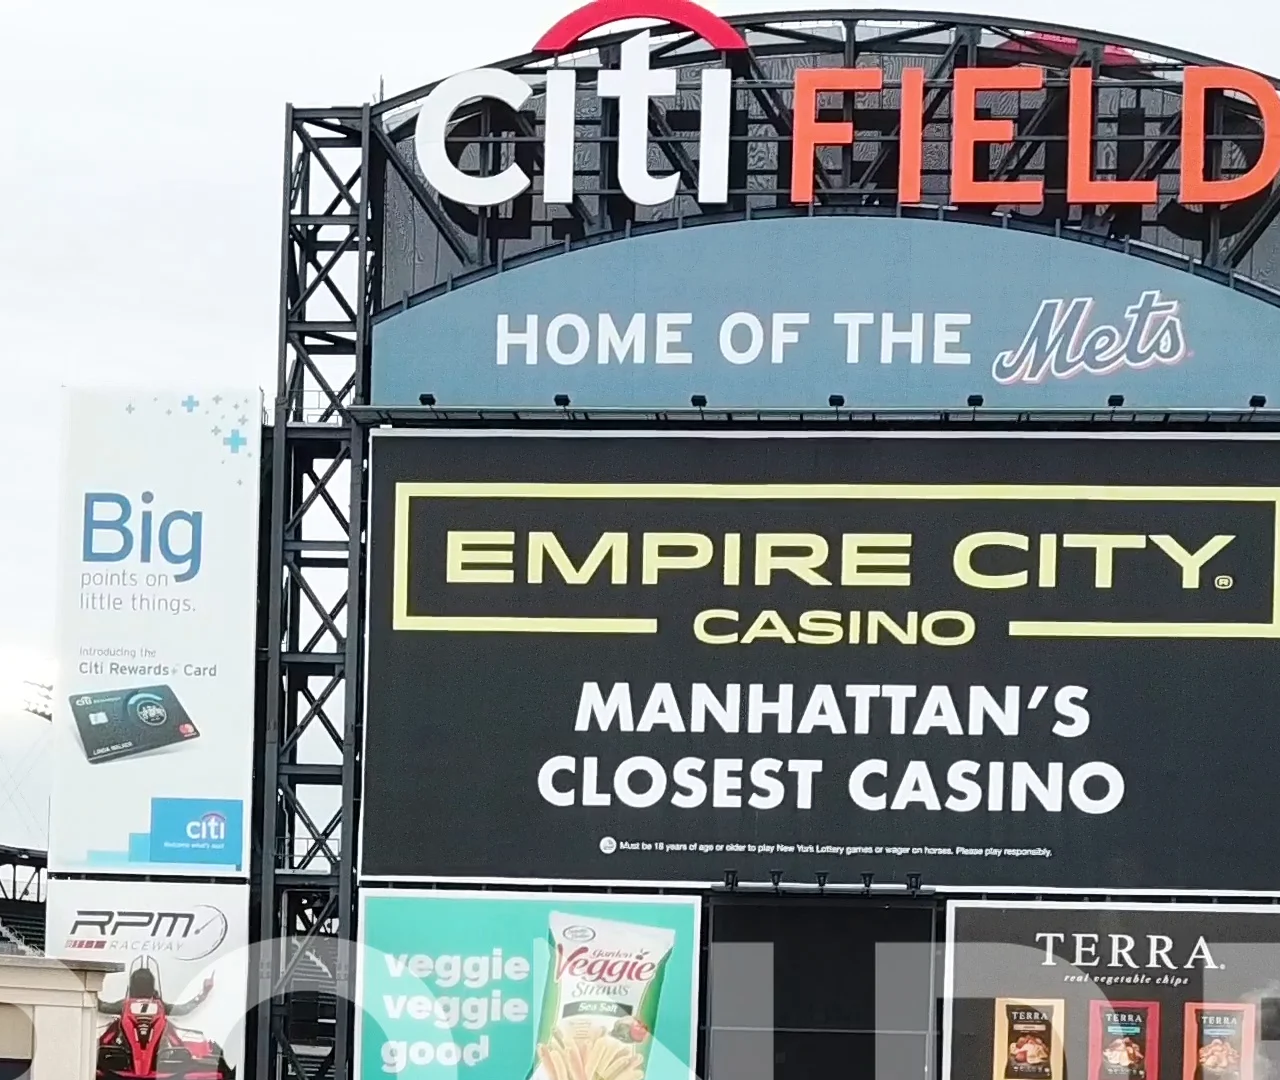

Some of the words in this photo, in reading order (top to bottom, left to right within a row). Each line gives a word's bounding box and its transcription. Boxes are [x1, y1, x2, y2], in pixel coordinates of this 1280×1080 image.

[415, 26, 732, 206] citi
[496, 311, 694, 366] HOME
[718, 311, 811, 365] OF
[832, 312, 971, 365] THE
[992, 291, 1186, 384] Mets
[83, 491, 203, 582] Big
[446, 531, 912, 586] EMPIRE
[81, 569, 138, 588] points
[146, 573, 168, 586] on
[80, 593, 122, 610] little
[132, 593, 196, 615] things.
[693, 610, 976, 645] CASINO
[140, 648, 156, 658] the
[79, 662, 103, 674] Citi
[183, 664, 217, 677] Card
[574, 681, 1089, 737] MANHATTAN'S
[537, 757, 823, 809] CLOSEST
[847, 759, 1125, 814] CASINO
[186, 816, 225, 839] citi
[620, 841, 640, 850] Must
[665, 843, 687, 852] years
[757, 844, 775, 853] play
[985, 847, 1002, 857] play
[70, 910, 195, 938] RPM
[109, 940, 184, 951] RACEWAY
[592, 949, 632, 958] Garden
[1035, 933, 1220, 969] TERRA
[384, 948, 530, 988] veggie
[556, 943, 656, 983] Veggie
[572, 982, 629, 997] Straws
[1064, 973, 1088, 983] real
[1094, 974, 1151, 985] vegetable
[1156, 975, 1188, 986] chips
[383, 989, 528, 1030] veggie
[578, 1003, 597, 1011] Sea
[599, 1003, 617, 1013] Salt
[1012, 1011, 1048, 1021] TERRA
[1106, 1014, 1142, 1023] TERRA
[1201, 1015, 1237, 1025] TERRA
[381, 1035, 489, 1073] good
